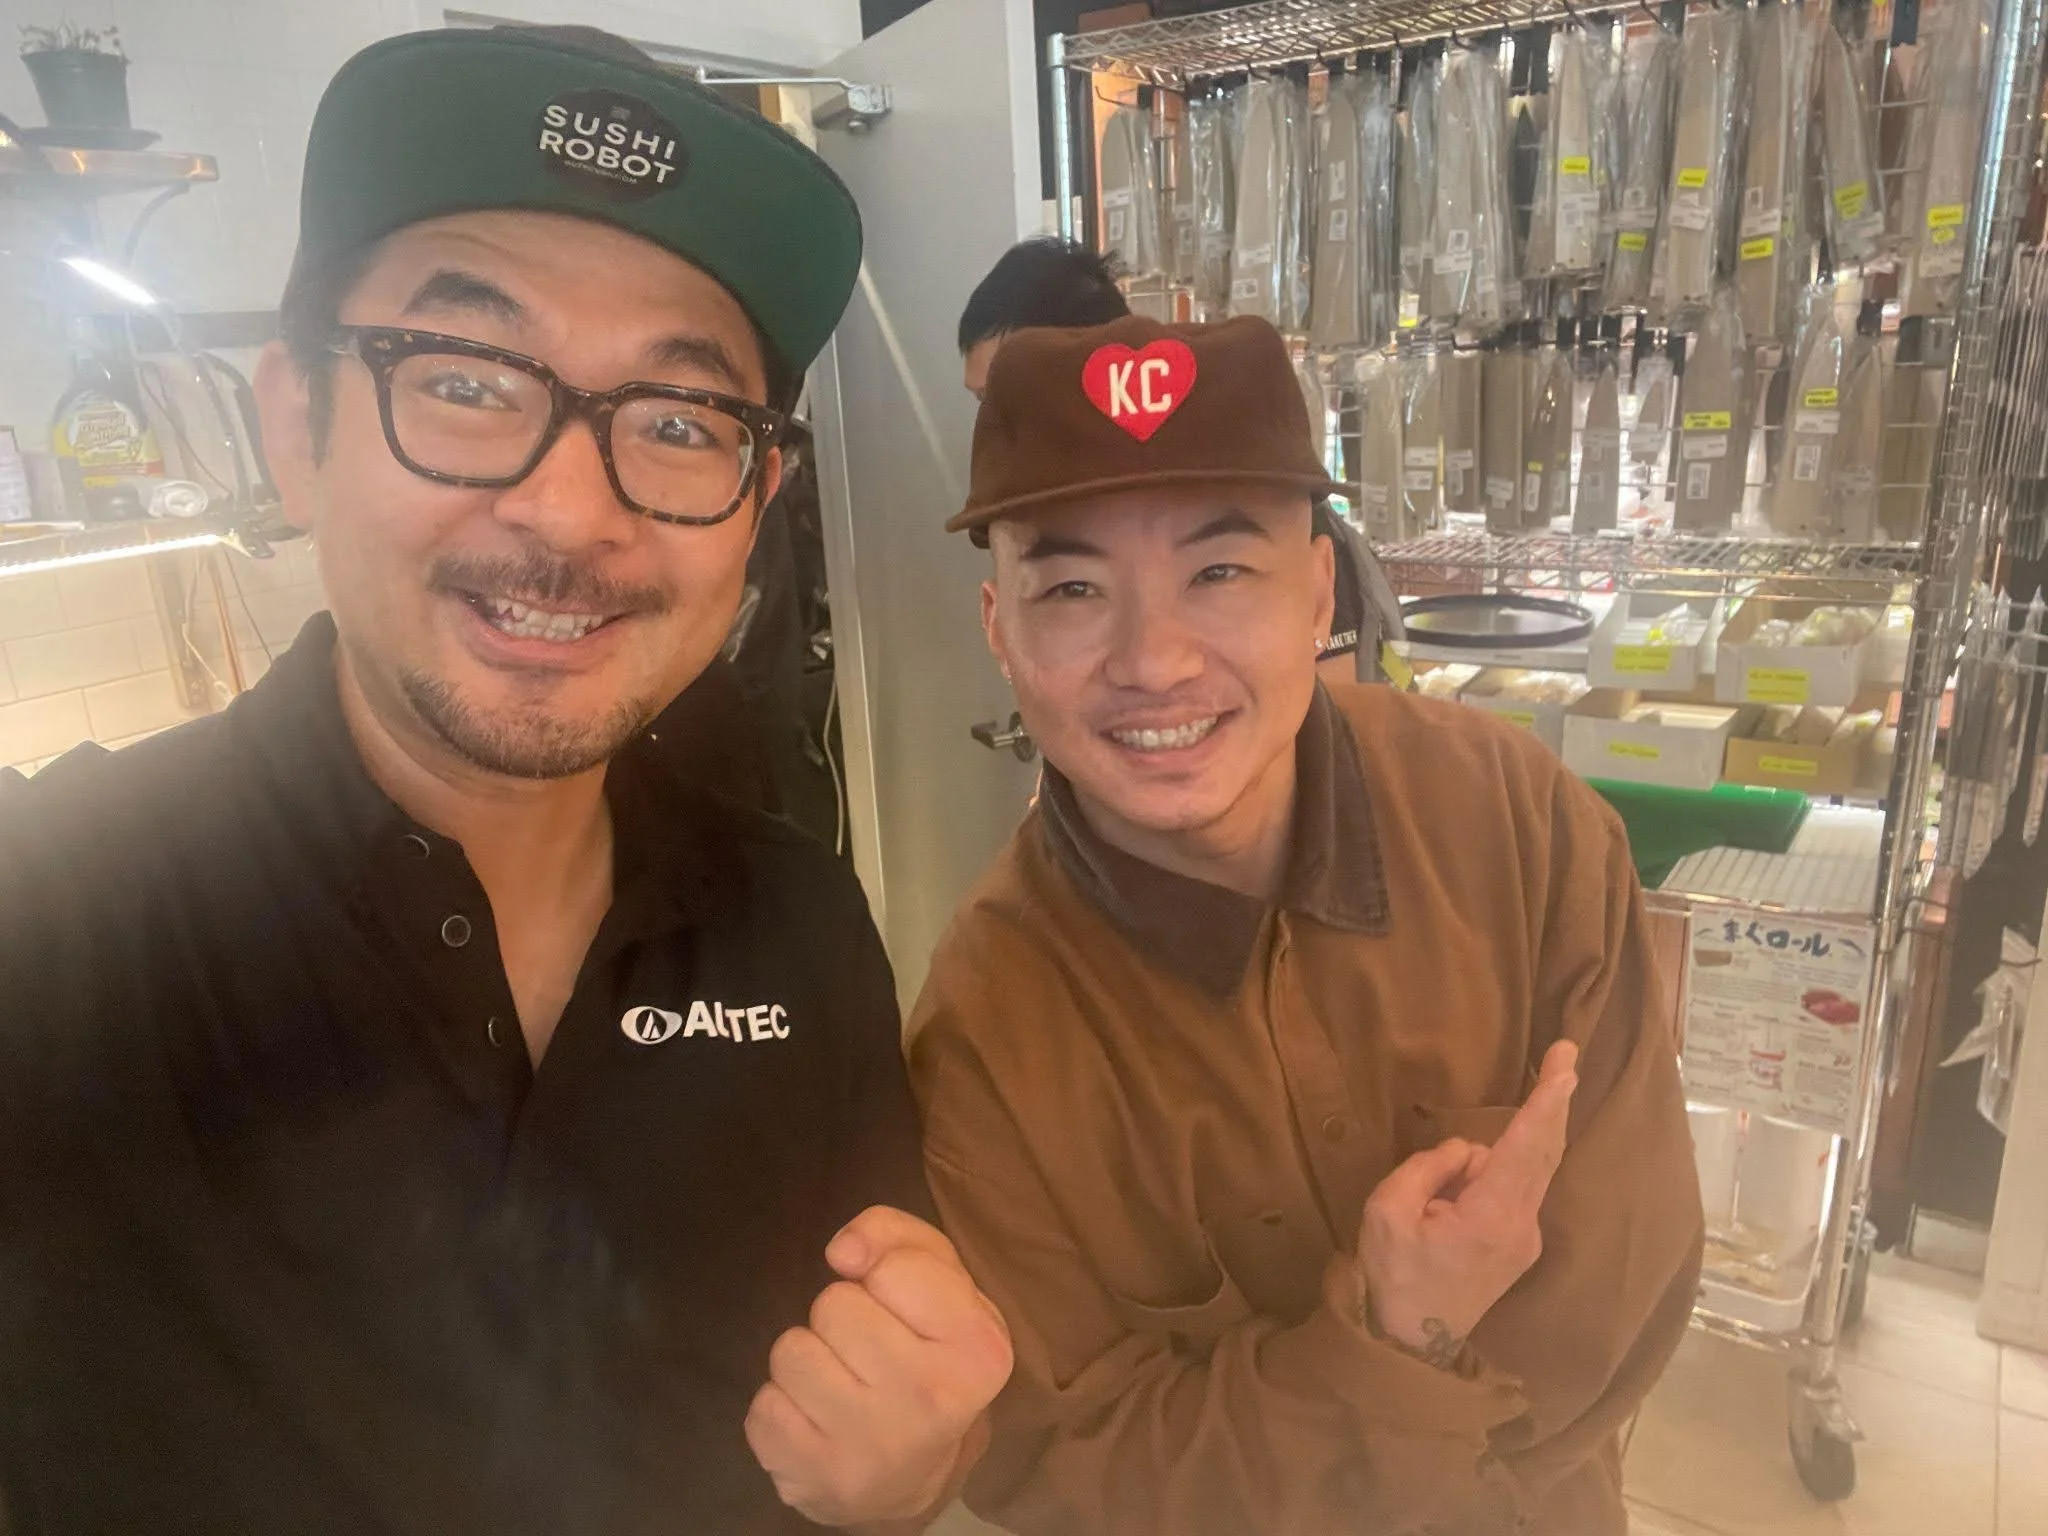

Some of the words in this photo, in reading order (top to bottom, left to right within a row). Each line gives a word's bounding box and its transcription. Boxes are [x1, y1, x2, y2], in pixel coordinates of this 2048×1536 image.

[539, 129, 676, 183] ROBOT
[544, 105, 676, 160] SUSHI
[1109, 358, 1172, 417] KC
